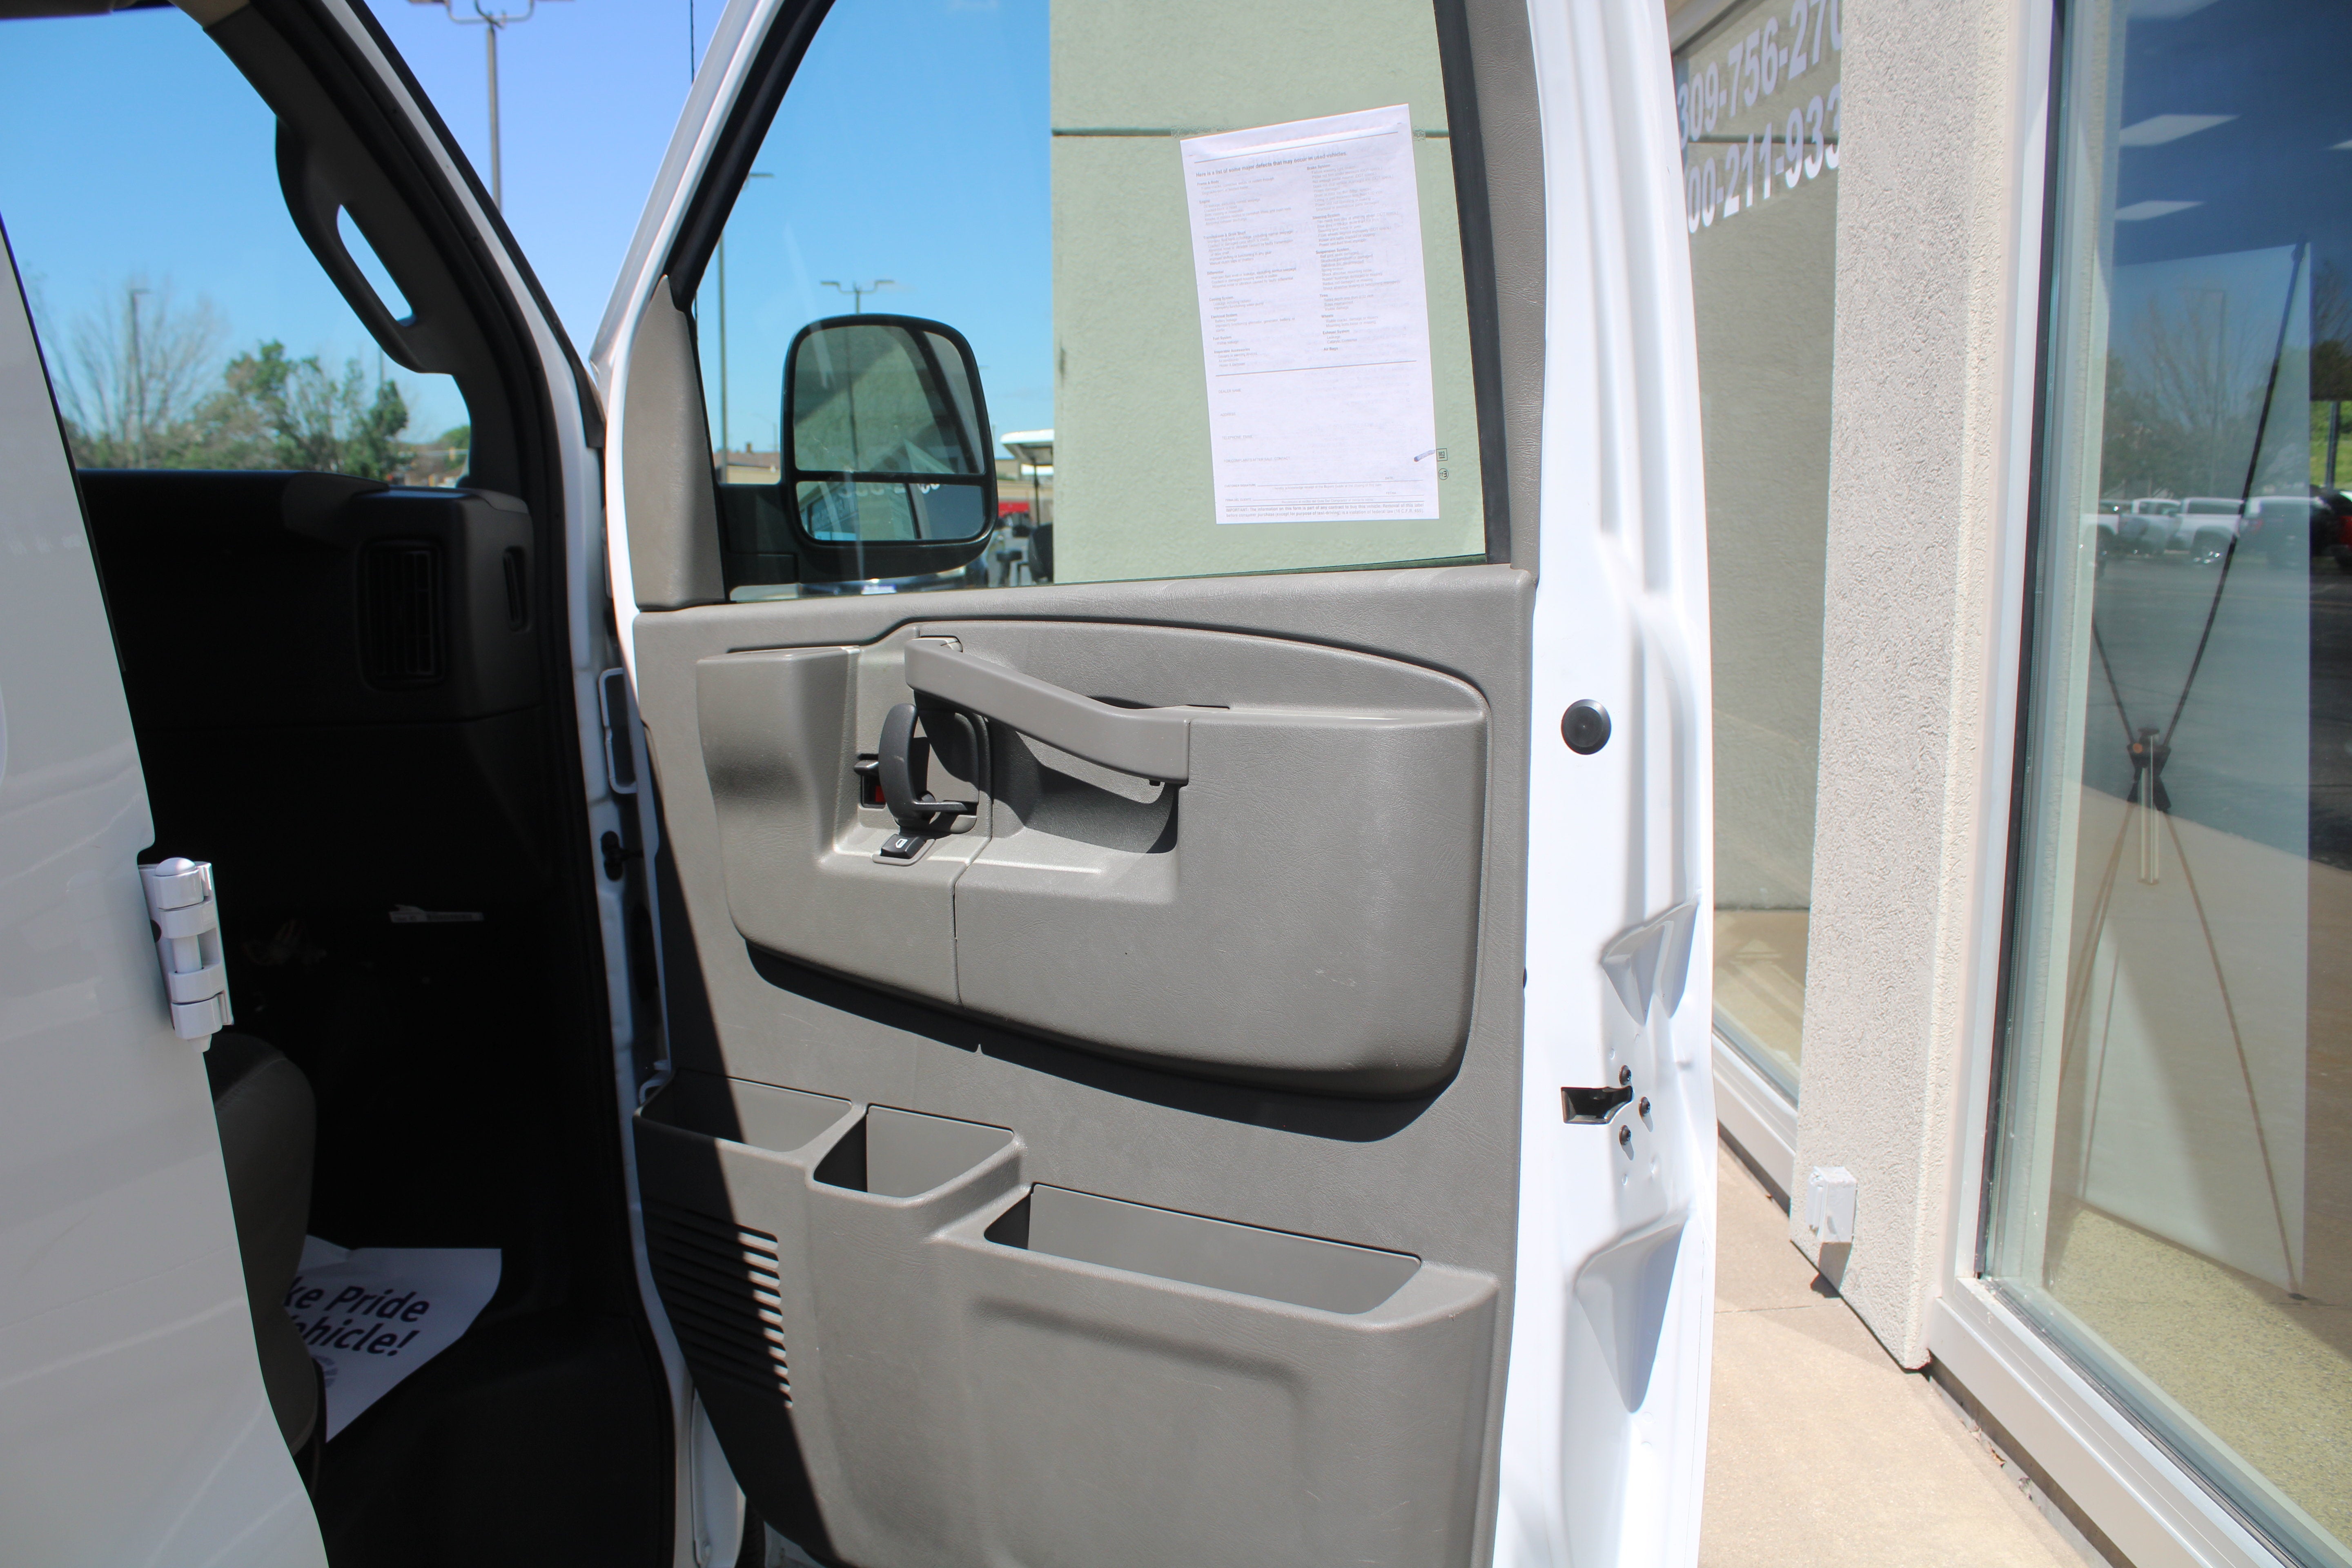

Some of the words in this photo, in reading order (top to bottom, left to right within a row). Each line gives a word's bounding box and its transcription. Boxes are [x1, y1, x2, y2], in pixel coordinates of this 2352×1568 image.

[1684, 83, 1841, 233] 00-211-933
[324, 1286, 430, 1322] Pride
[292, 1315, 420, 1356] hicle!
